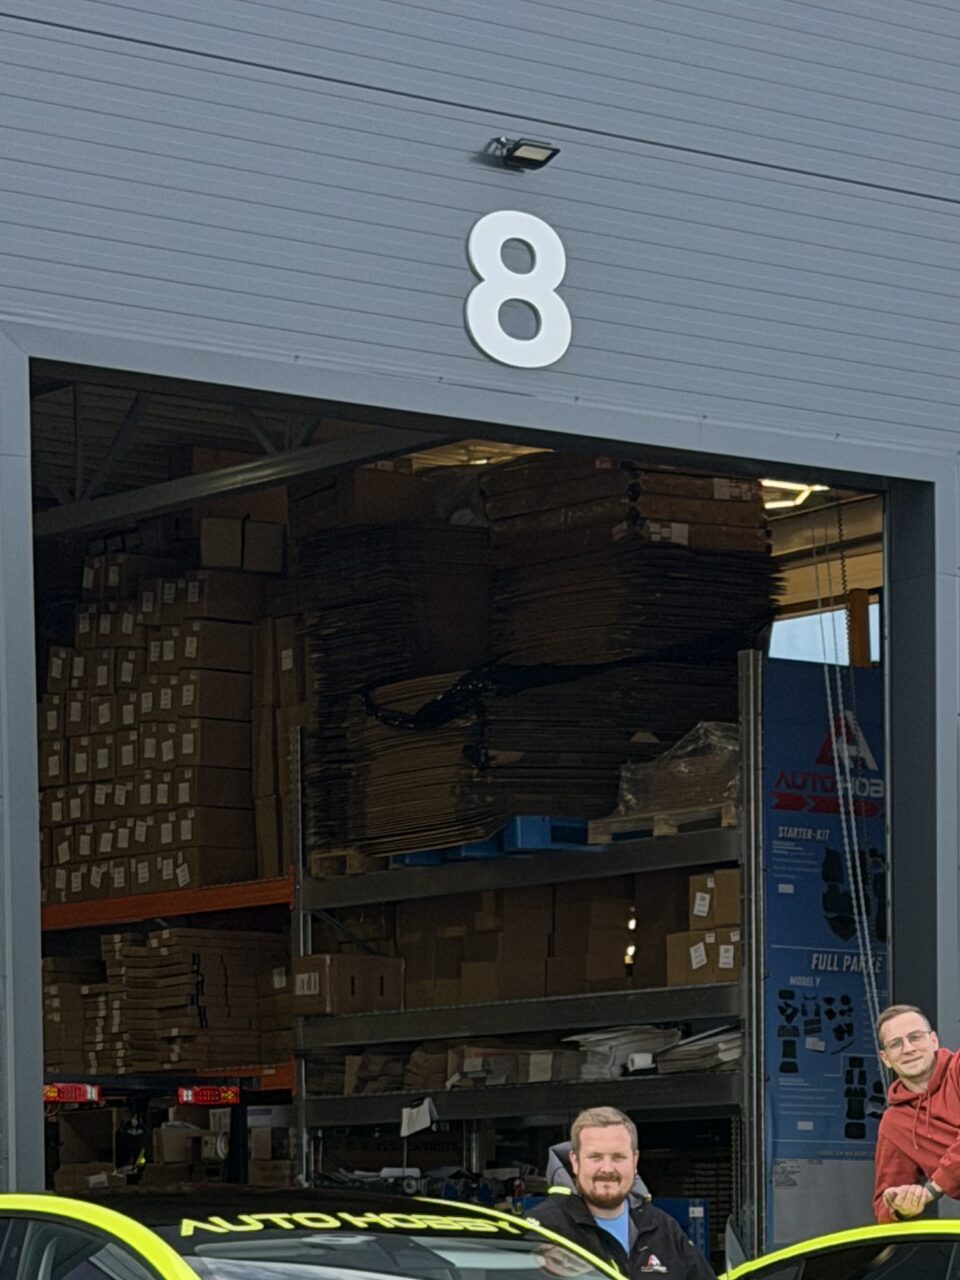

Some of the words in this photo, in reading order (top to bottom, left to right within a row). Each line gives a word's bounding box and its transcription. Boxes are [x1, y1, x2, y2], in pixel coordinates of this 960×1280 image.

[466, 210, 572, 369] 8
[838, 776, 885, 798] HOB
[778, 826, 830, 841] STARTER-KIT
[811, 953, 840, 971] FULL
[180, 1213, 341, 1236] AUTO
[337, 1212, 521, 1234] HOBBY
